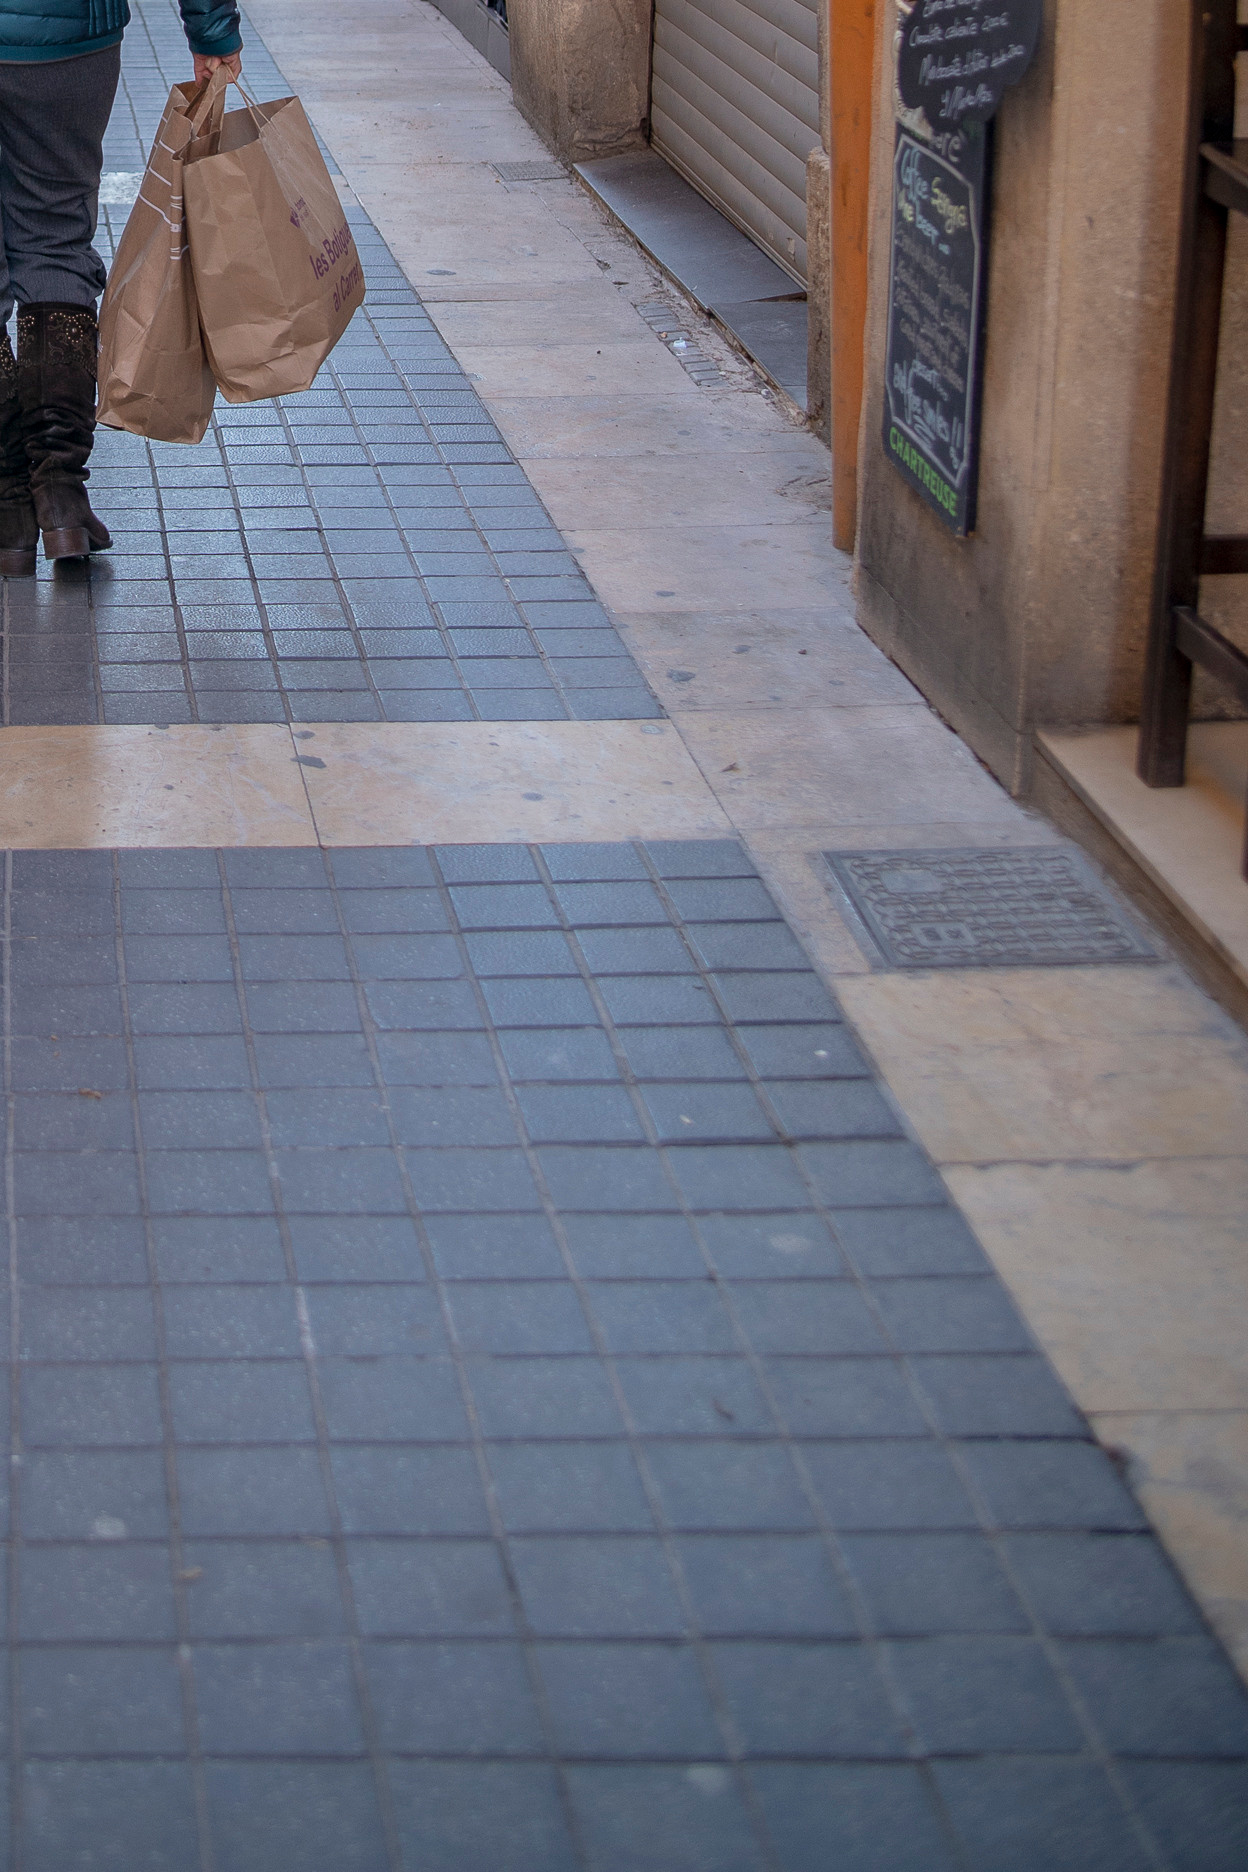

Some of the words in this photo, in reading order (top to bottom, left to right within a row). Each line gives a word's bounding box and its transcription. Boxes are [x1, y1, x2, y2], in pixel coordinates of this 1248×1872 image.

[309, 252, 331, 281] les
[333, 281, 342, 313] al
[889, 426, 958, 518] CHARTREUSE
